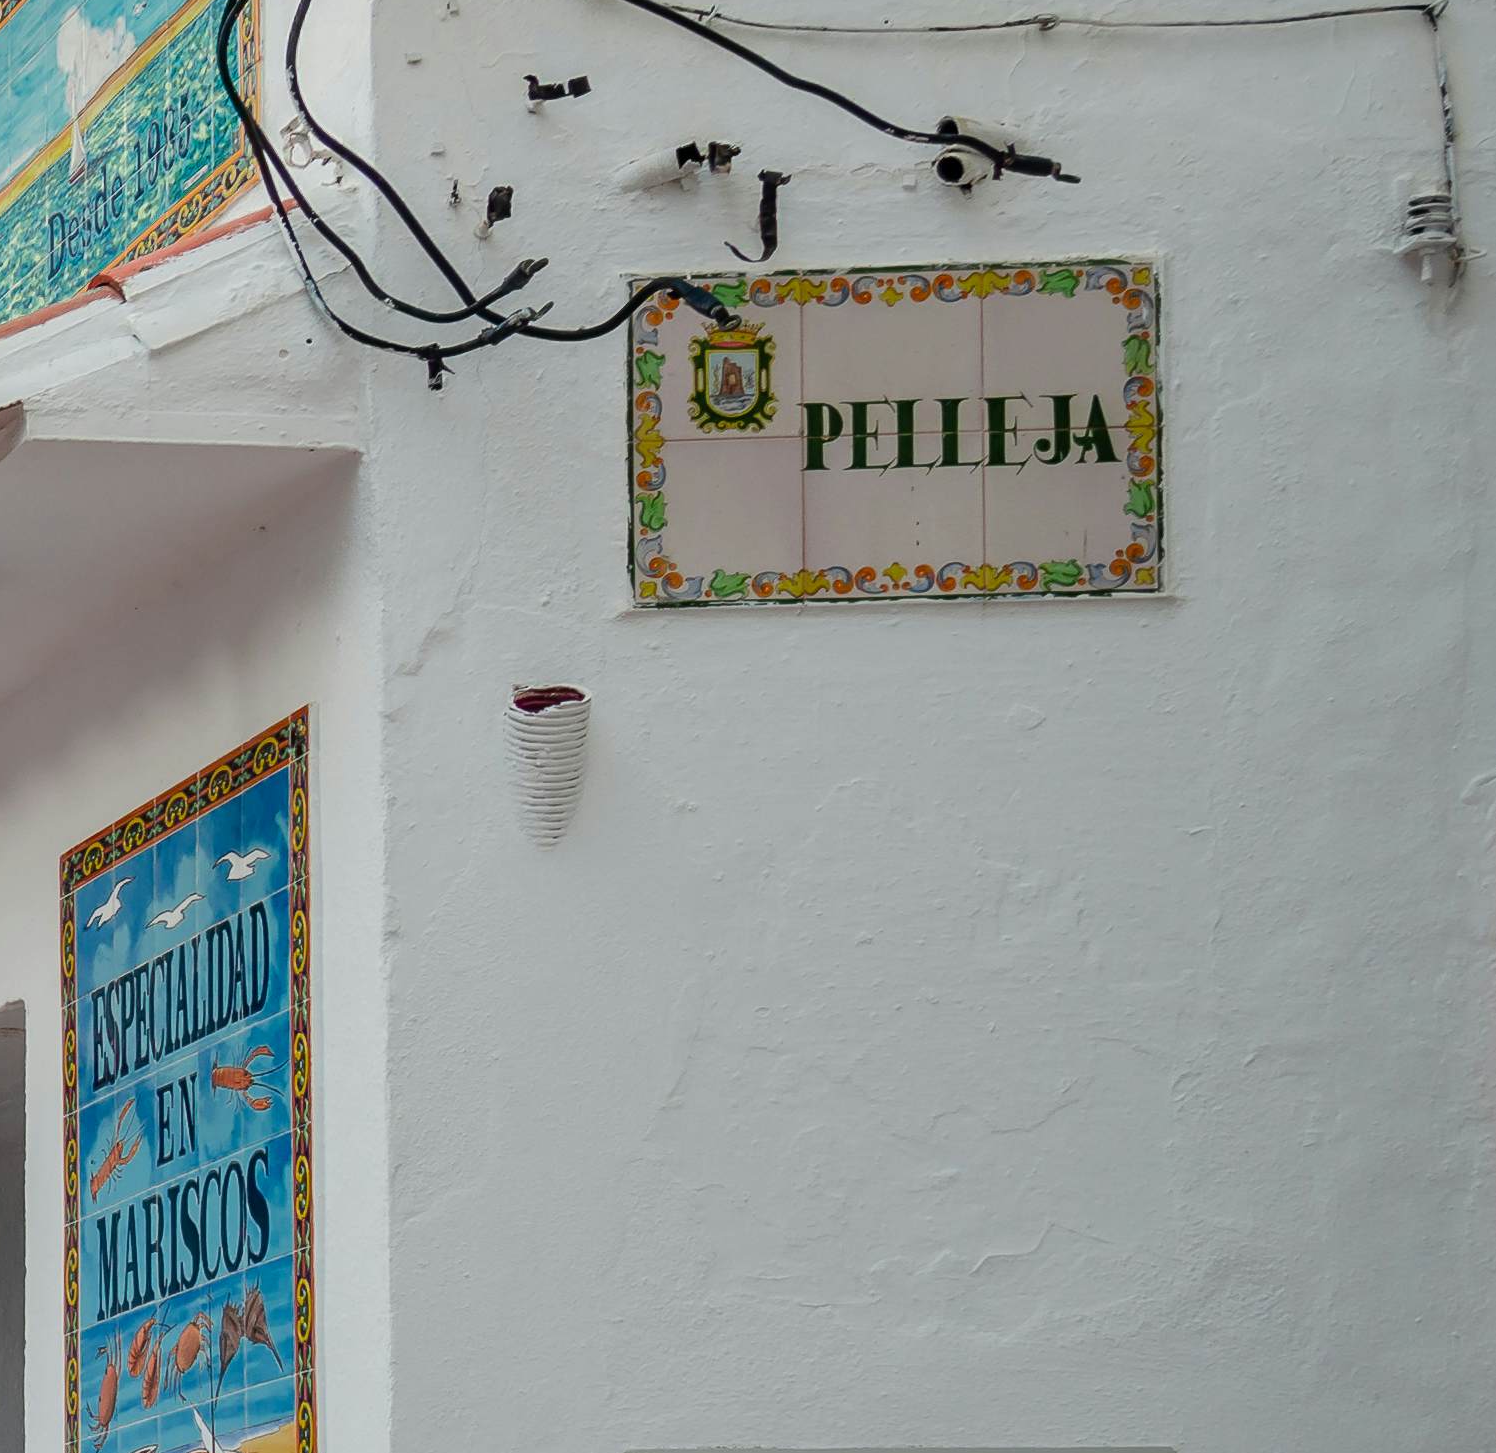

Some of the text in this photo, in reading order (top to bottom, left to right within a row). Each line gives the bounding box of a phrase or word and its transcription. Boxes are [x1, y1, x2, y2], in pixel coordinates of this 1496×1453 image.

[47, 91, 192, 281] Desde 1985
[797, 393, 1128, 477] PELLEJA
[91, 900, 270, 1092] ESPECIALIDAD
[156, 1071, 199, 1168] EN
[96, 1145, 271, 1322] MARISCOS
